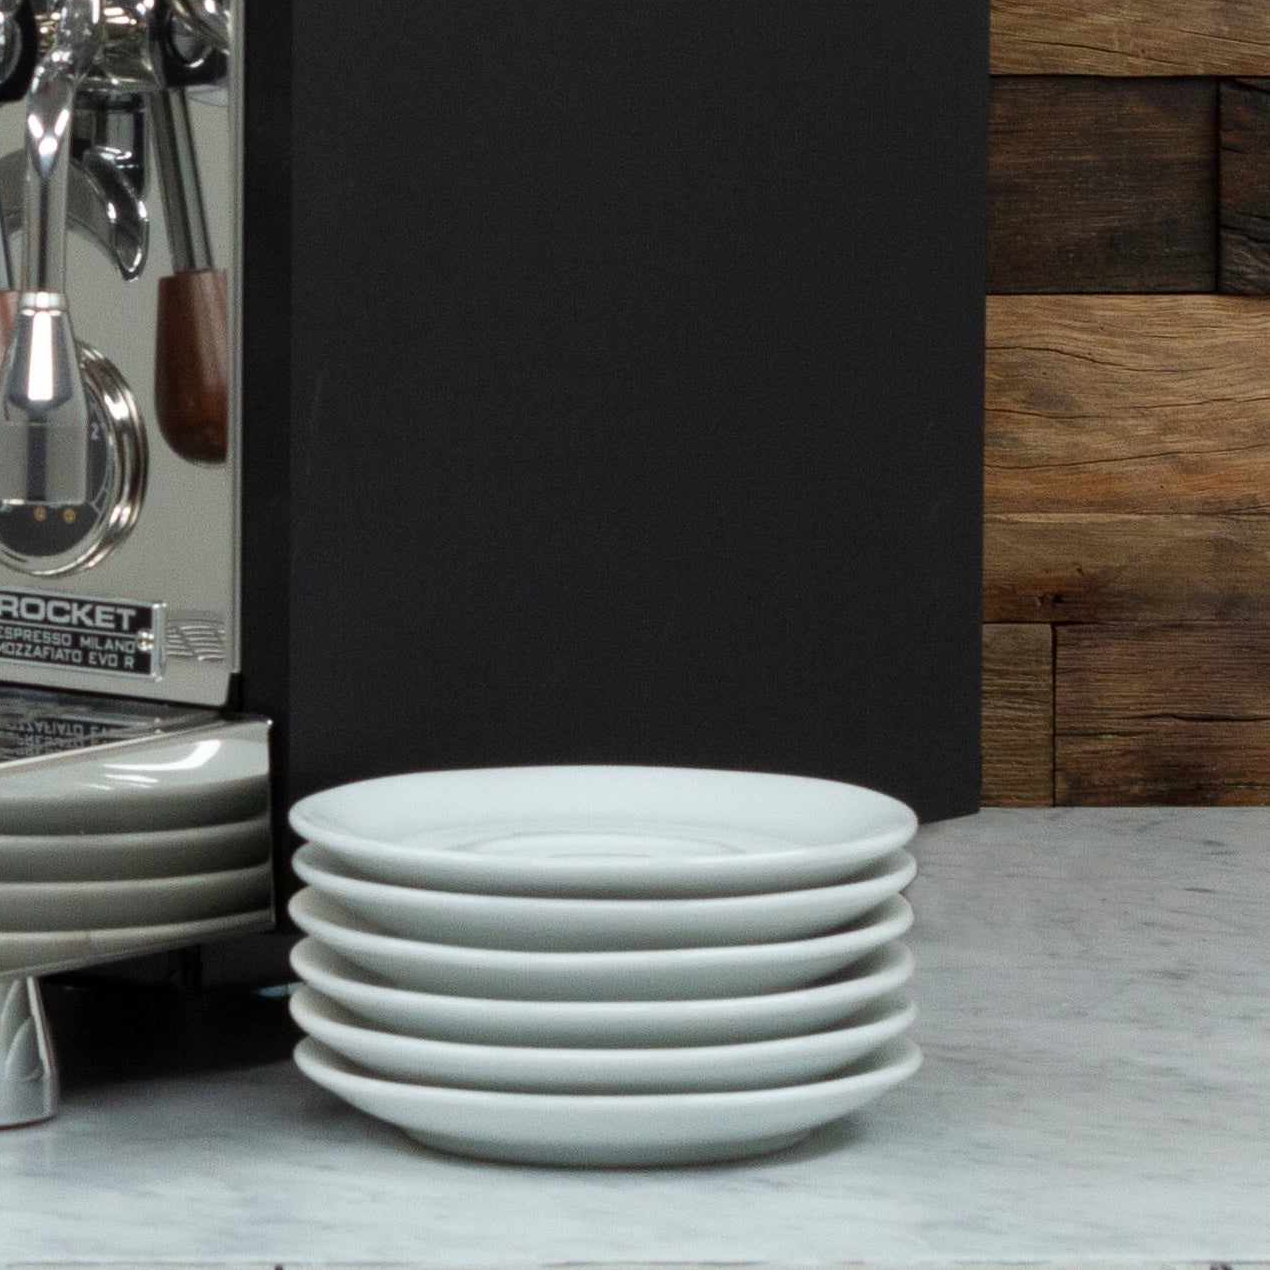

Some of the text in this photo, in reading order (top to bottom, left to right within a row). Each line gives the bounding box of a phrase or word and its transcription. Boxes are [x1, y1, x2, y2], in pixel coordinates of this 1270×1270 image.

[80, 635, 136, 655] MILANO
[88, 651, 119, 668] EVO
[124, 655, 135, 669] R
